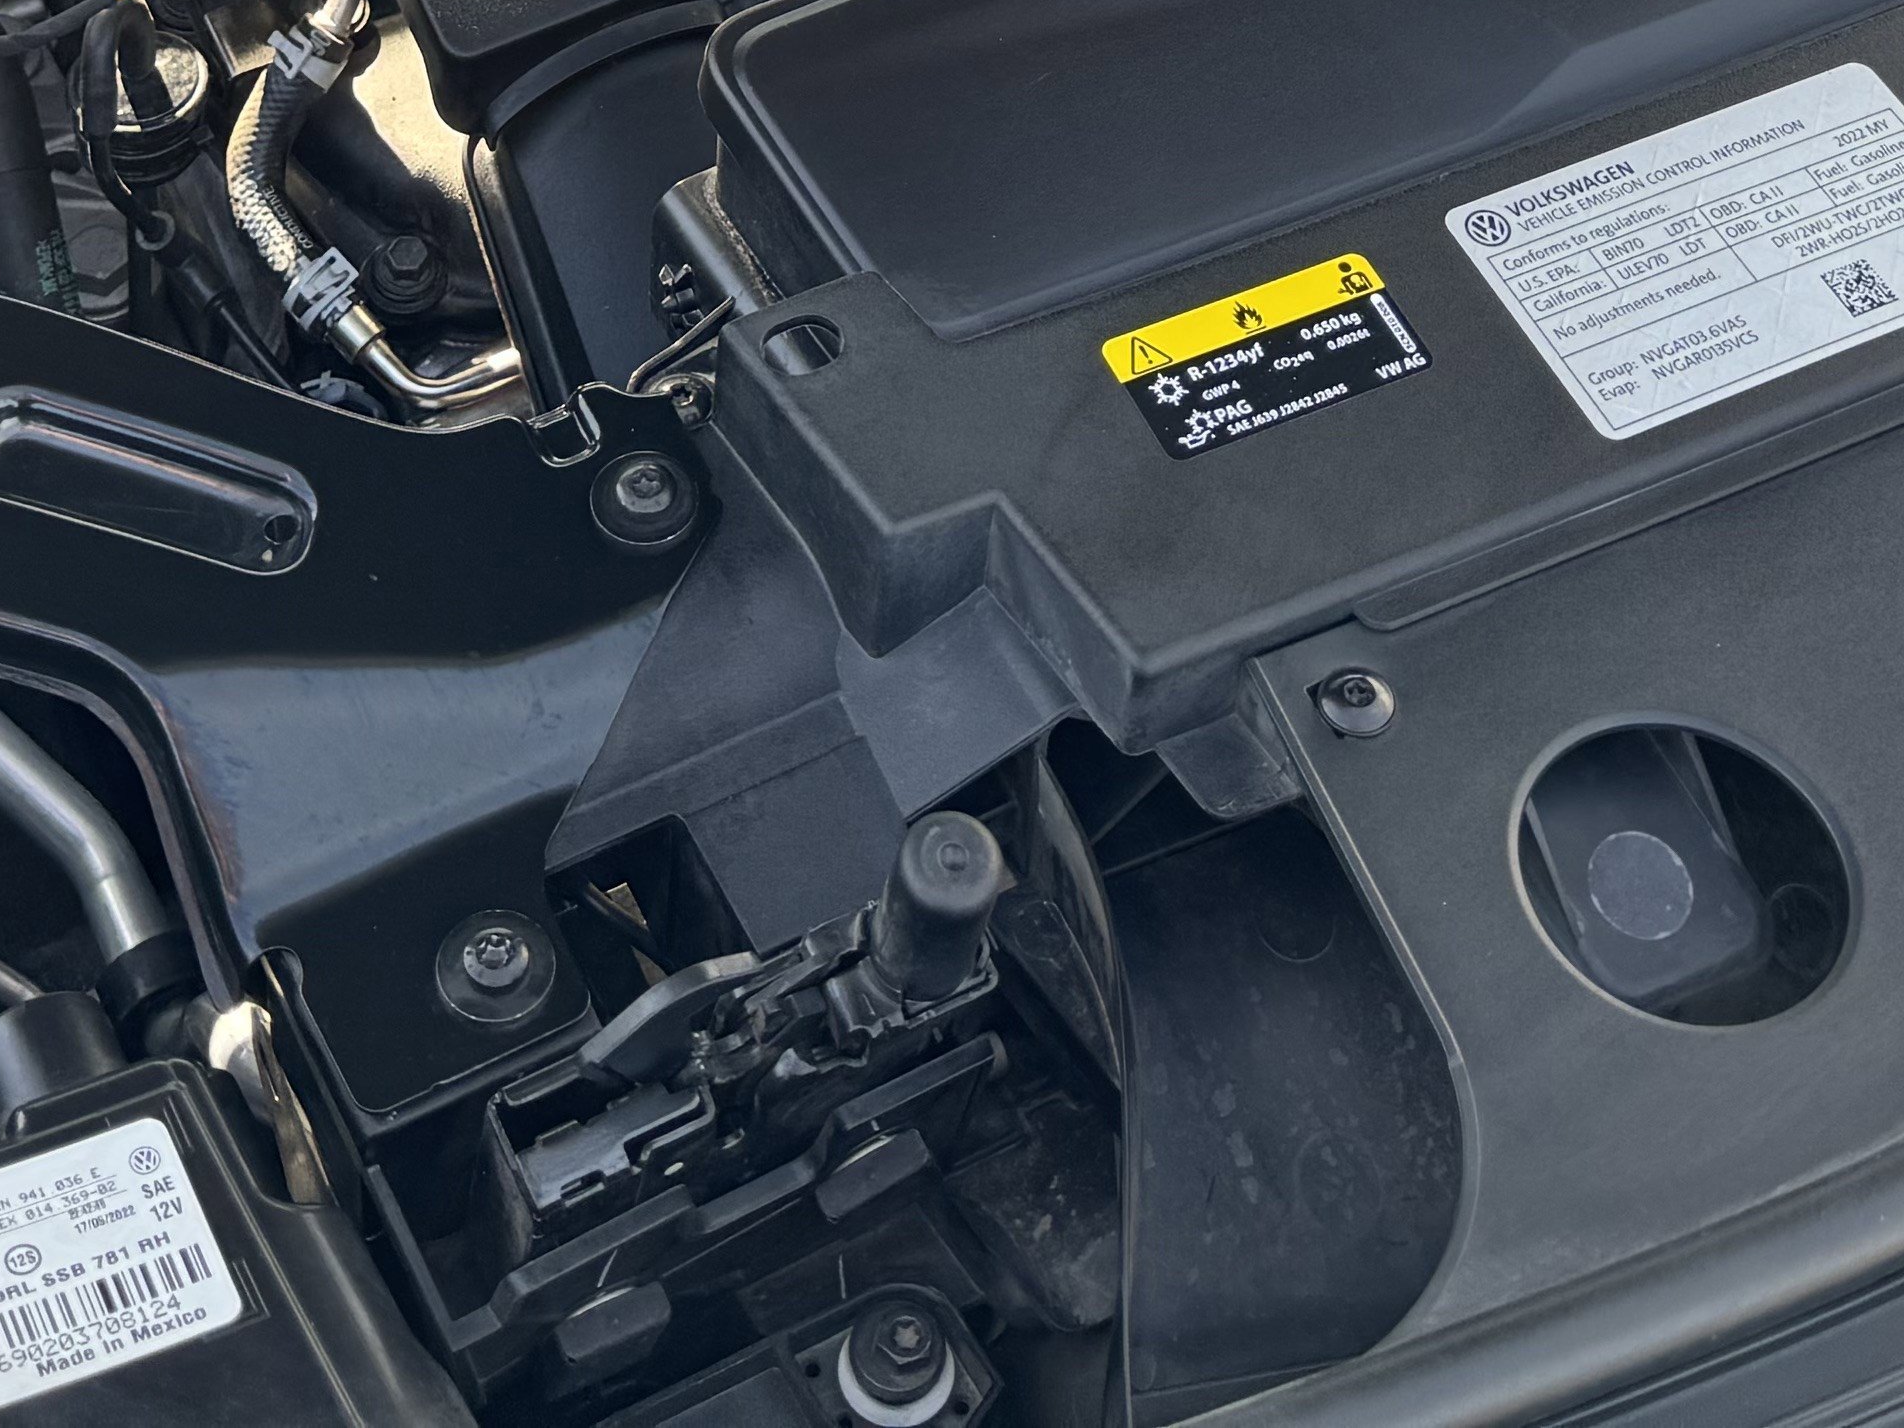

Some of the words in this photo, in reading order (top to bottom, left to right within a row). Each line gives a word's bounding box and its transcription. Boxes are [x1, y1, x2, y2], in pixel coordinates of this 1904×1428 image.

[1502, 240, 1571, 270] Conforms
[1569, 233, 1588, 245] to
[1589, 204, 1669, 238] regulations:
[1833, 127, 1867, 147] 2022
[1864, 118, 1888, 135] MY
[1505, 161, 1633, 216] VOLKSWAGEN
[1517, 202, 1577, 231] VEHICLE
[1576, 178, 1645, 210] EMISSION
[1645, 155, 1710, 184] CONTROL
[1709, 119, 1804, 160] INFORMATION
[1517, 275, 1548, 292] U.S.
[1545, 264, 1580, 282] EPA:
[1601, 237, 1644, 260] BIN70
[1663, 215, 1700, 237] LDT2
[1709, 200, 1746, 219] OBD:
[1748, 190, 1772, 204] CA
[1813, 161, 1848, 180] Fuel:
[1533, 281, 1606, 311] California:
[1616, 252, 1669, 279] ULEV70
[1678, 237, 1706, 256] LDT
[1724, 219, 1759, 238] OBD:
[1764, 208, 1787, 223] CA
[1828, 179, 1864, 199] Fuel:
[1300, 317, 1340, 340] 0.650
[1338, 312, 1361, 325] kg
[1552, 325, 1576, 340] No
[1578, 291, 1664, 330] adjustments
[1664, 267, 1720, 296] needed.
[1187, 342, 1263, 380] R-1234yf
[1375, 360, 1402, 378] VW
[1403, 352, 1426, 370] AG
[1587, 361, 1638, 385] Group:
[1640, 315, 1746, 363] NVGAT03.6VAS
[1597, 381, 1640, 401] Evap:
[1651, 330, 1758, 379] NVGAR0135VCS
[1201, 383, 1229, 400] GWP
[1231, 379, 1240, 389] 4
[1213, 399, 1252, 422] PAG
[1226, 418, 1252, 435] SAE
[1251, 408, 1278, 426] J639
[1279, 396, 1313, 416] J2842
[1313, 383, 1347, 403] J2845
[89, 1166, 101, 1179] E
[141, 1175, 174, 1199] SAE
[149, 1196, 182, 1221] 12V
[41, 1262, 85, 1287] SSB
[91, 1246, 129, 1268] 781
[137, 1231, 170, 1253] RH
[36, 1348, 94, 1376] Made
[130, 1307, 206, 1342] Mexico
